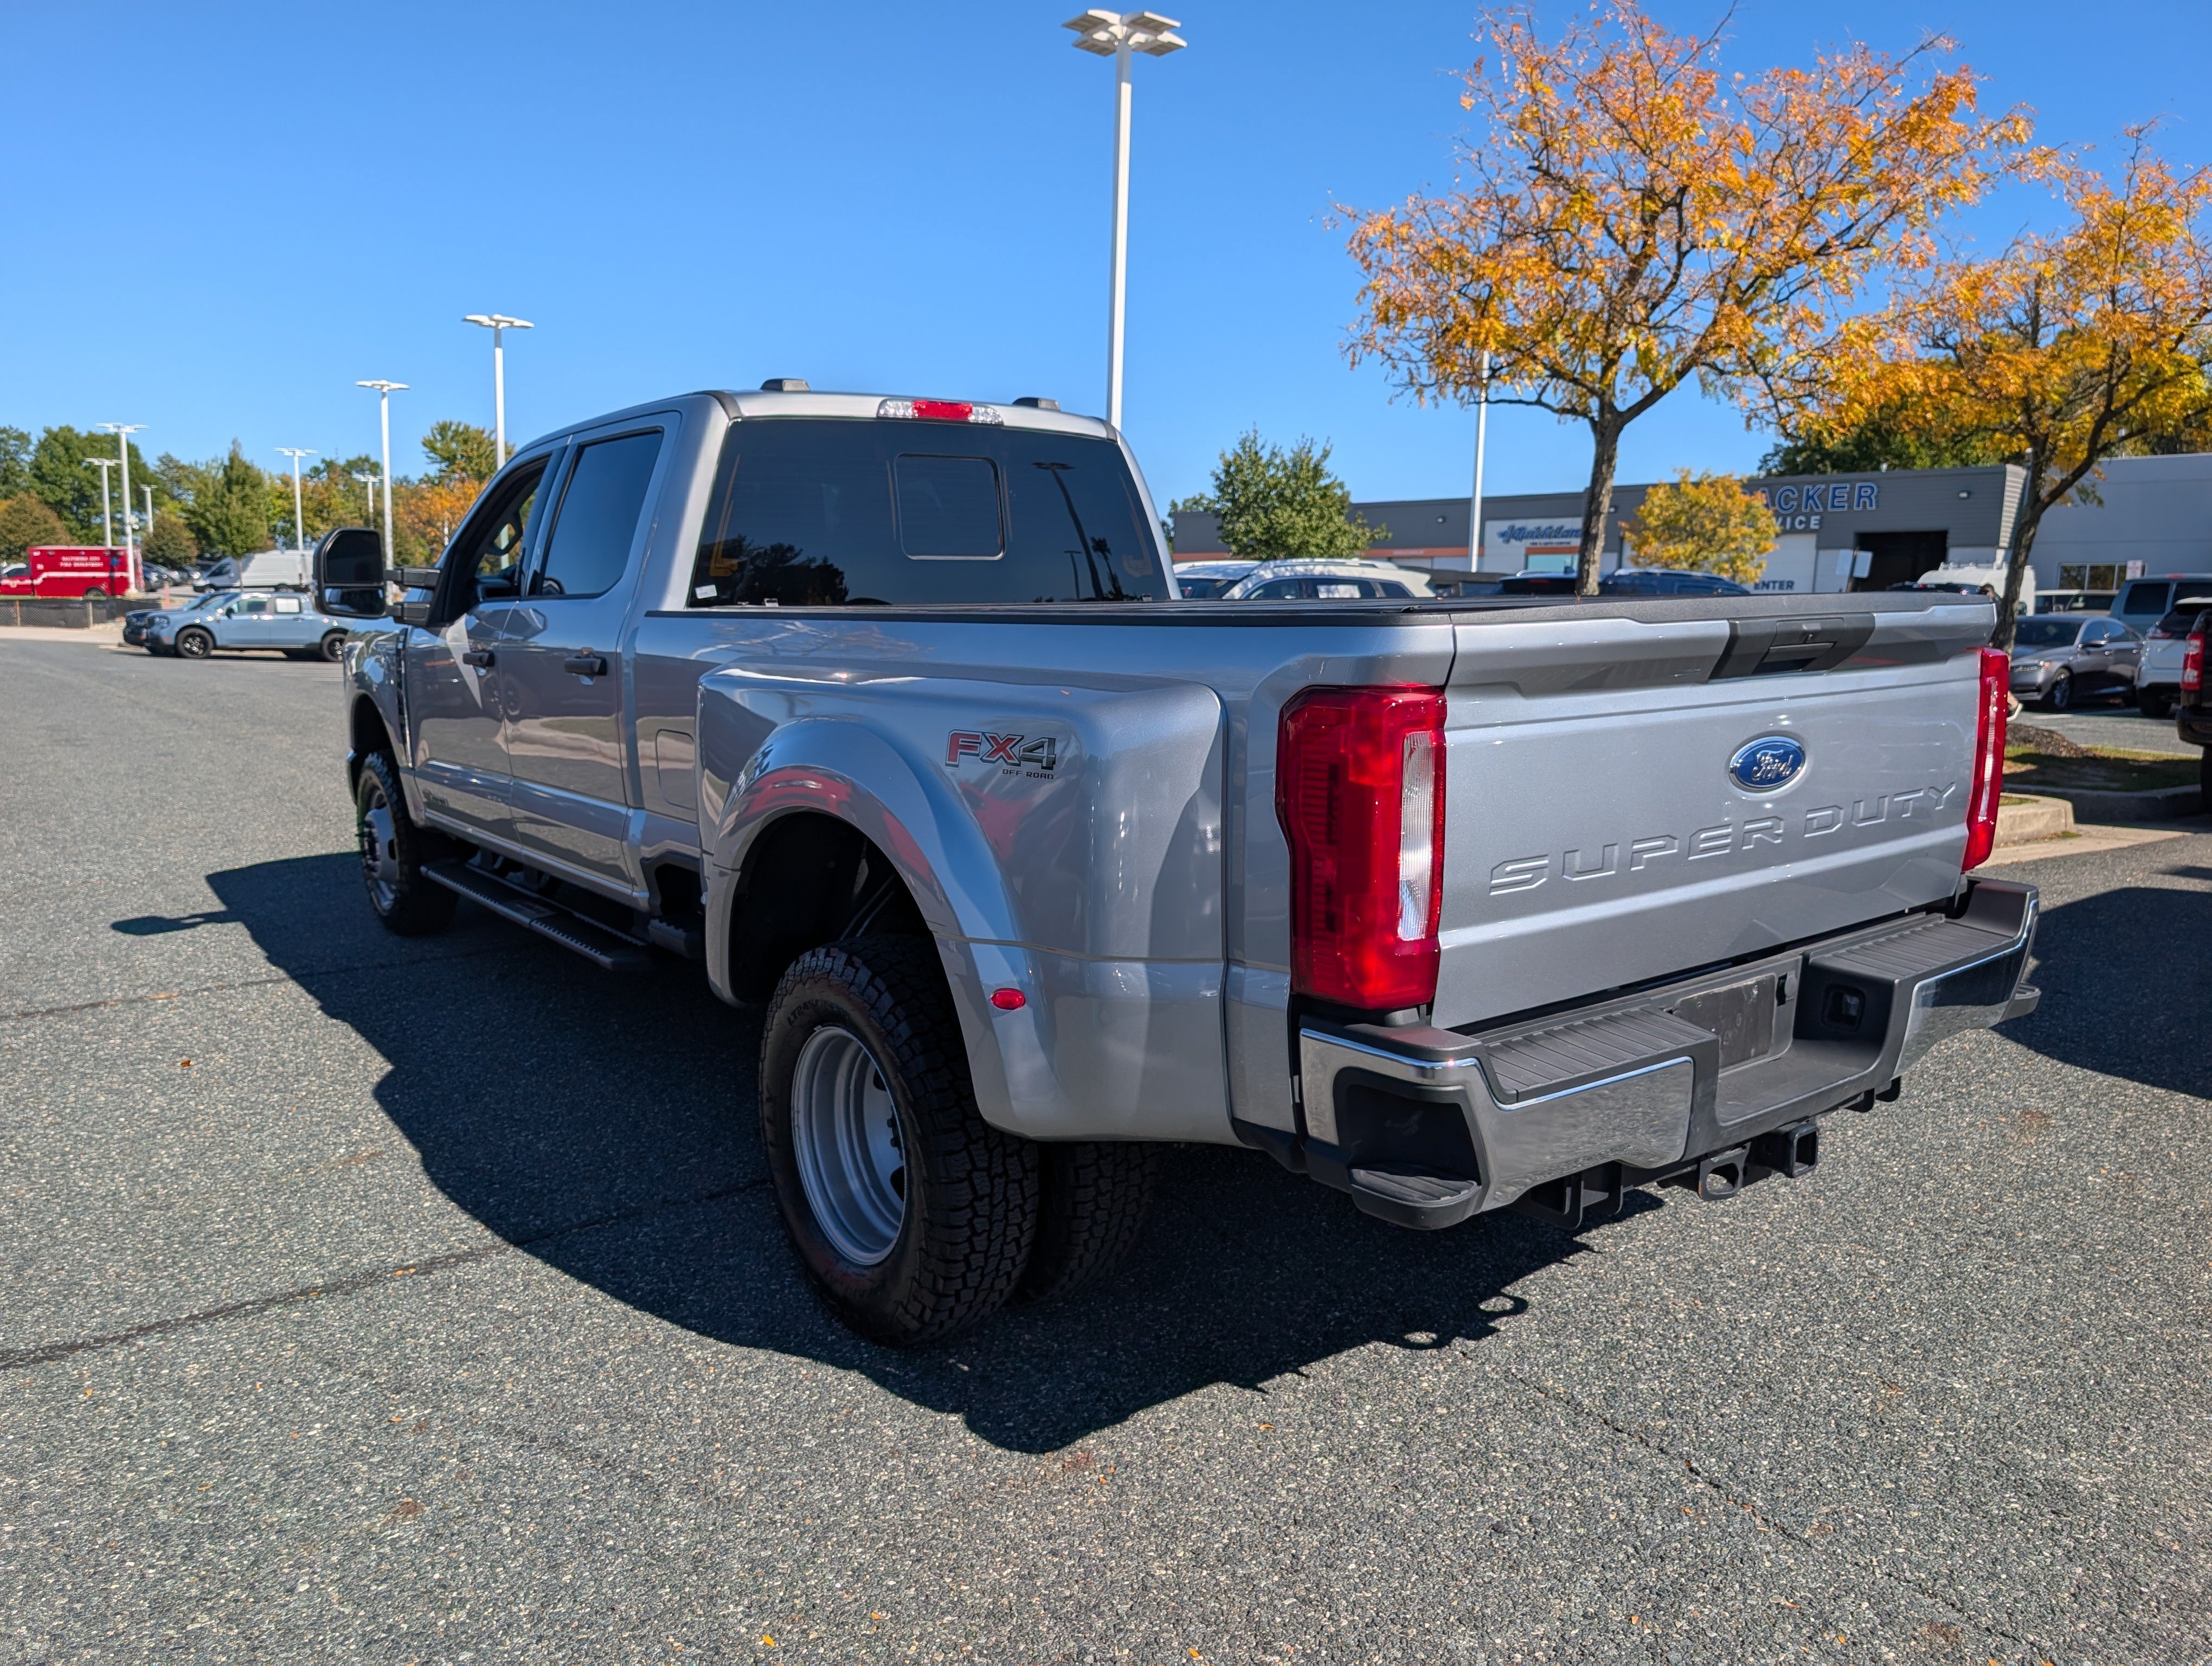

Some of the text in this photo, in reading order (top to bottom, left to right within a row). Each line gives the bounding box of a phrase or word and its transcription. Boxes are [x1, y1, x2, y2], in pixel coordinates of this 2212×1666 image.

[945, 729, 1056, 771] FX4
[1752, 749, 1793, 781] Ford
[1026, 771, 1054, 780] ROAD
[1489, 781, 1956, 895] SUPER DUTY
